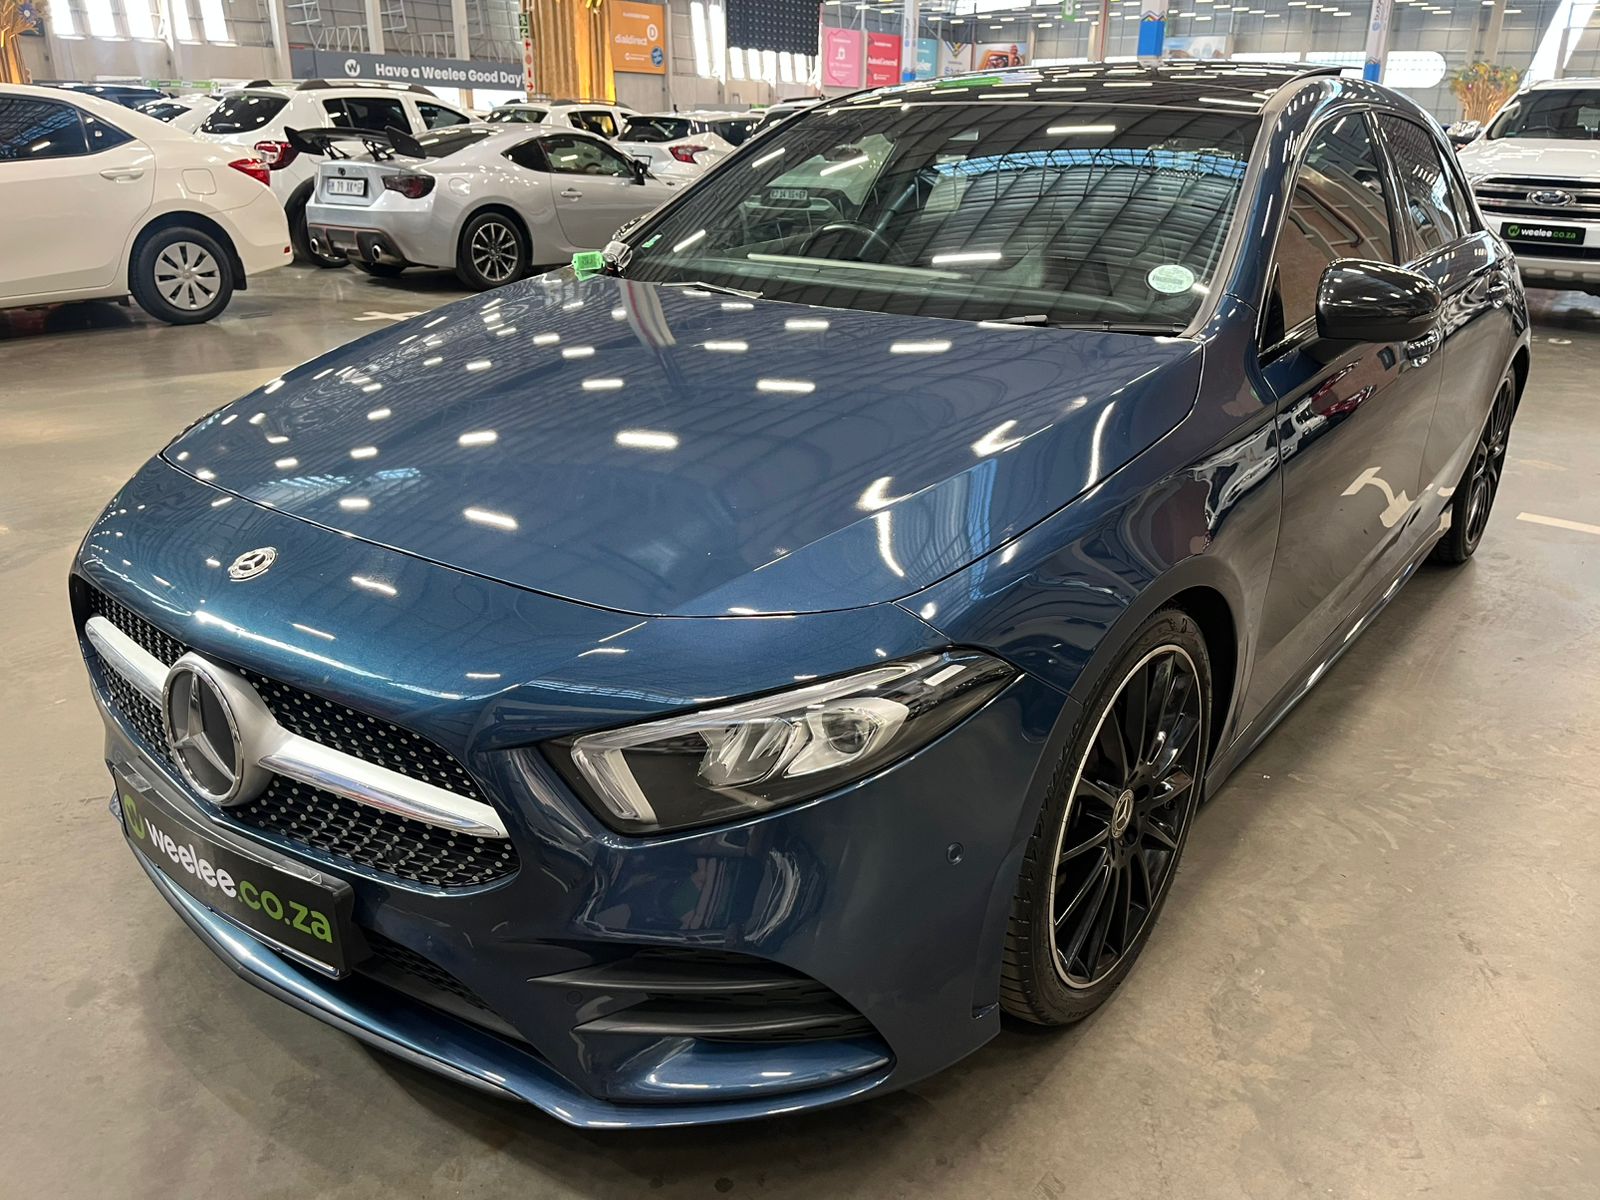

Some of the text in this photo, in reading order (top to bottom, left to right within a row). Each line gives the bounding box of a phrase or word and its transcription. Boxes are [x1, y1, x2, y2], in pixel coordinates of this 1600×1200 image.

[375, 63, 409, 78] Have
[411, 68, 420, 79] a
[421, 66, 467, 82] Weelee
[467, 69, 499, 83] Good
[1521, 228, 1576, 238] weelee.co.za
[144, 816, 333, 943] weelee.co.za
